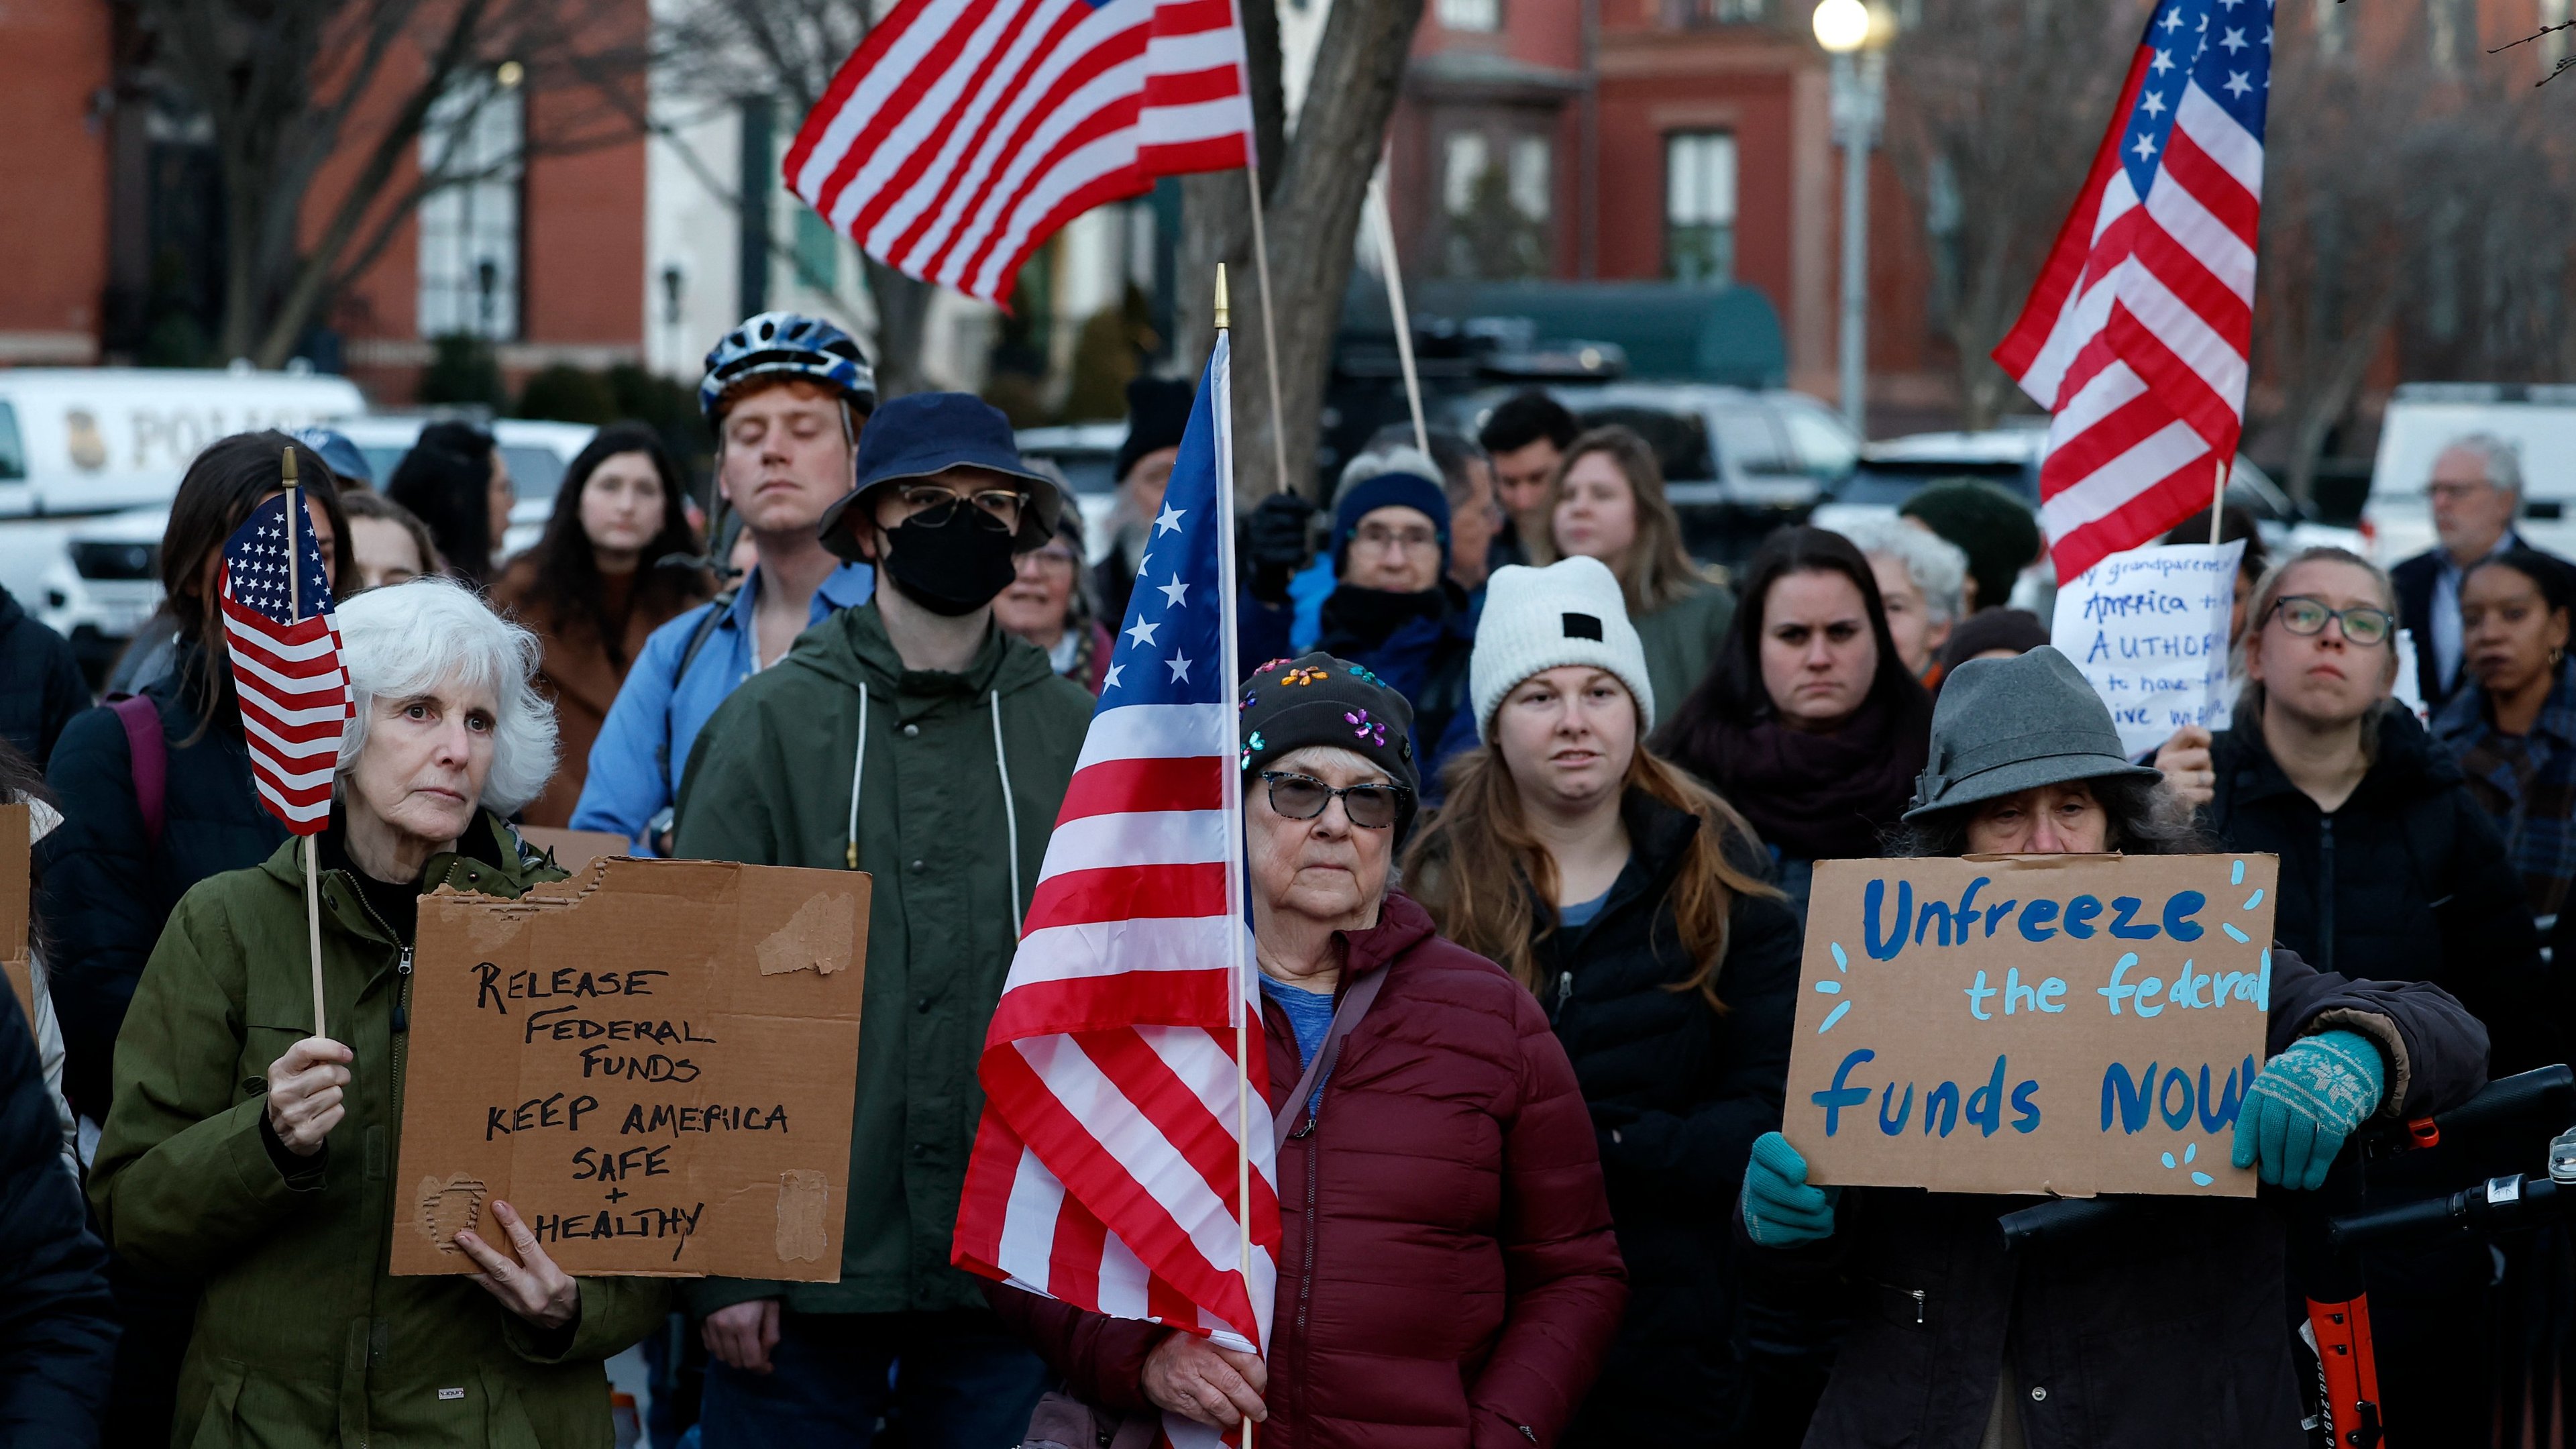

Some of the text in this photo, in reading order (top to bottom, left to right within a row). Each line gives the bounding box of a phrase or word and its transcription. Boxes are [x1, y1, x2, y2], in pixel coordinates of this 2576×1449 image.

[2084, 589, 2190, 625] America
[2114, 703, 2151, 724] ive
[1864, 877, 2206, 961] Unfreeze
[471, 962, 669, 1015] RELEASE
[1965, 947, 2271, 1020] the federal
[525, 1005, 716, 1044] FEDERAL
[579, 1044, 702, 1083] FUNDS
[486, 1092, 788, 1141] KEEP AMERICA
[1811, 1049, 2256, 1138] funds NOW
[572, 1144, 671, 1182] SAFE
[535, 1202, 704, 1262] HEALTHY
